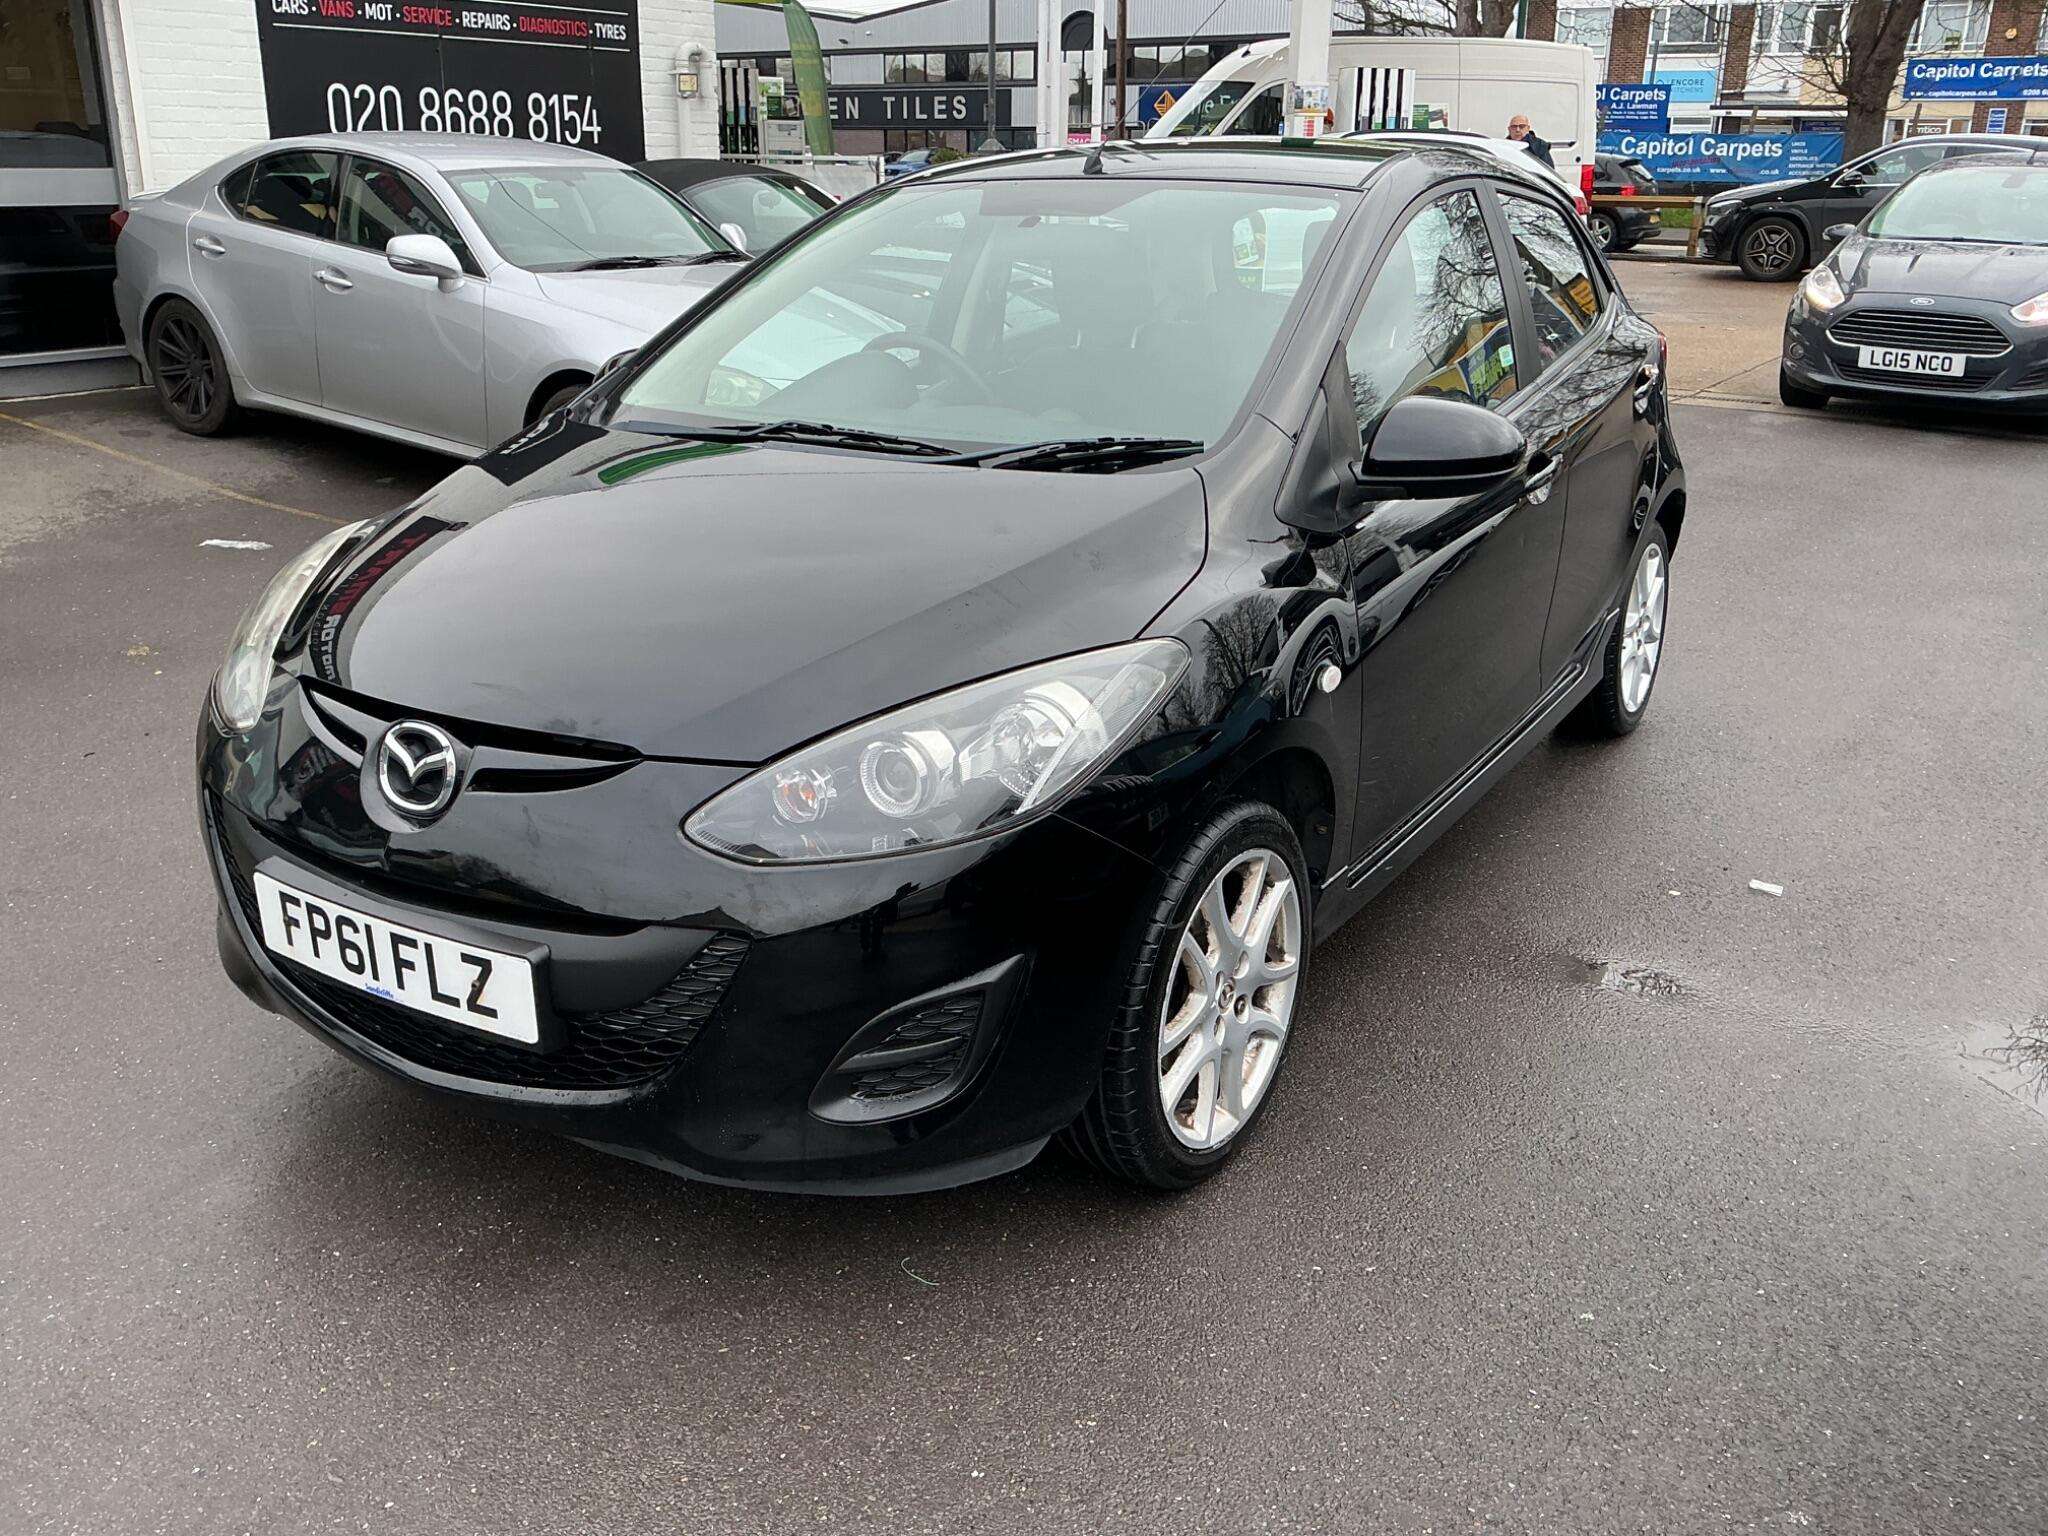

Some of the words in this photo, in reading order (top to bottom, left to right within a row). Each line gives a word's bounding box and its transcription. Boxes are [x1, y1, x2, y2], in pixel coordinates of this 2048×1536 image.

[272, 0, 309, 14] CARS
[319, 0, 355, 18] VANS
[365, 3, 393, 21] MOT
[403, 6, 452, 26] SERVICE
[462, 11, 511, 31] REPAIRS
[520, 16, 588, 38] DIAGNOSTICS
[594, 23, 626, 40] TYRES
[1913, 63, 1976, 81] Capitol
[882, 95, 967, 120] TILES
[1610, 87, 1667, 103] Carpets
[327, 82, 403, 134] 020
[419, 86, 513, 138] 8688
[527, 92, 602, 144] 8154
[1621, 136, 1694, 160] Capitol
[1701, 137, 1783, 161] Carpets
[1870, 350, 1911, 368] LG15
[1916, 354, 1953, 372] NCO
[278, 890, 380, 982] FP61
[389, 931, 499, 1020] FLZ
